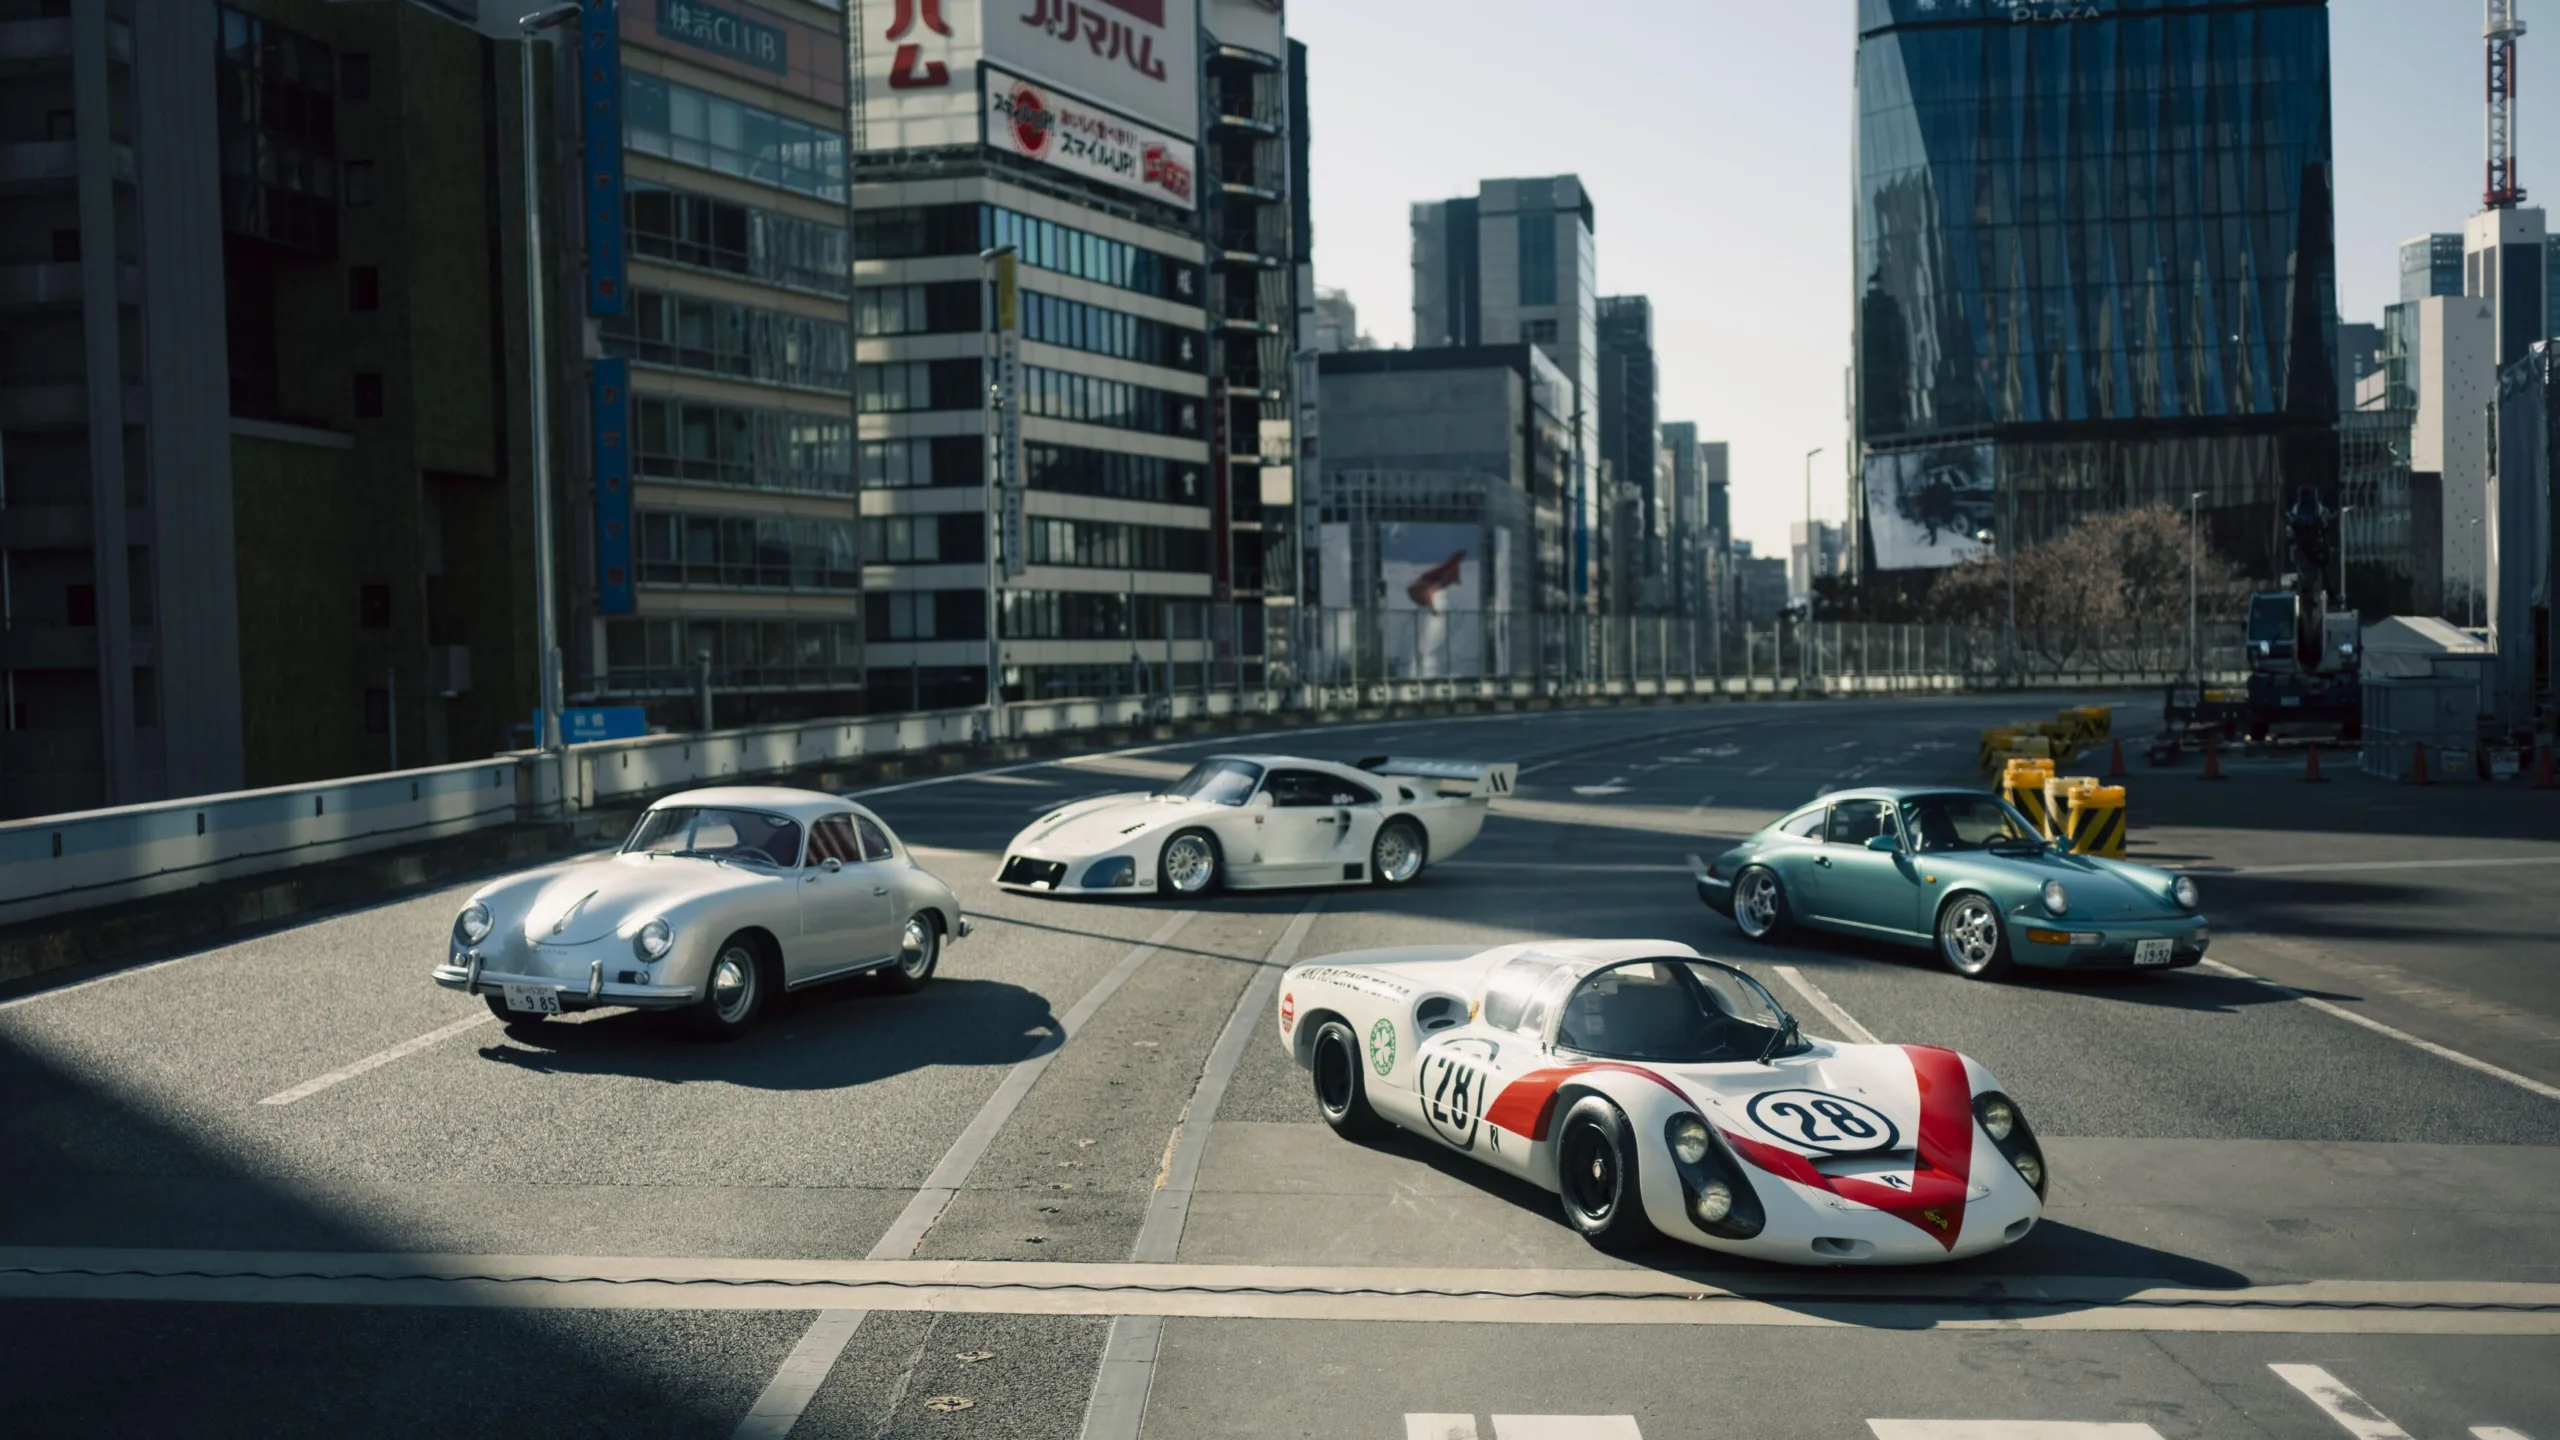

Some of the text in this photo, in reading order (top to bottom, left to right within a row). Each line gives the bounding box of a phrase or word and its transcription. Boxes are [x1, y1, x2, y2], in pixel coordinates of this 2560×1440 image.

[2012, 7, 2099, 22] PLAZA
[1433, 1048, 1480, 1130] 28
[1771, 1100, 1877, 1141] 28
